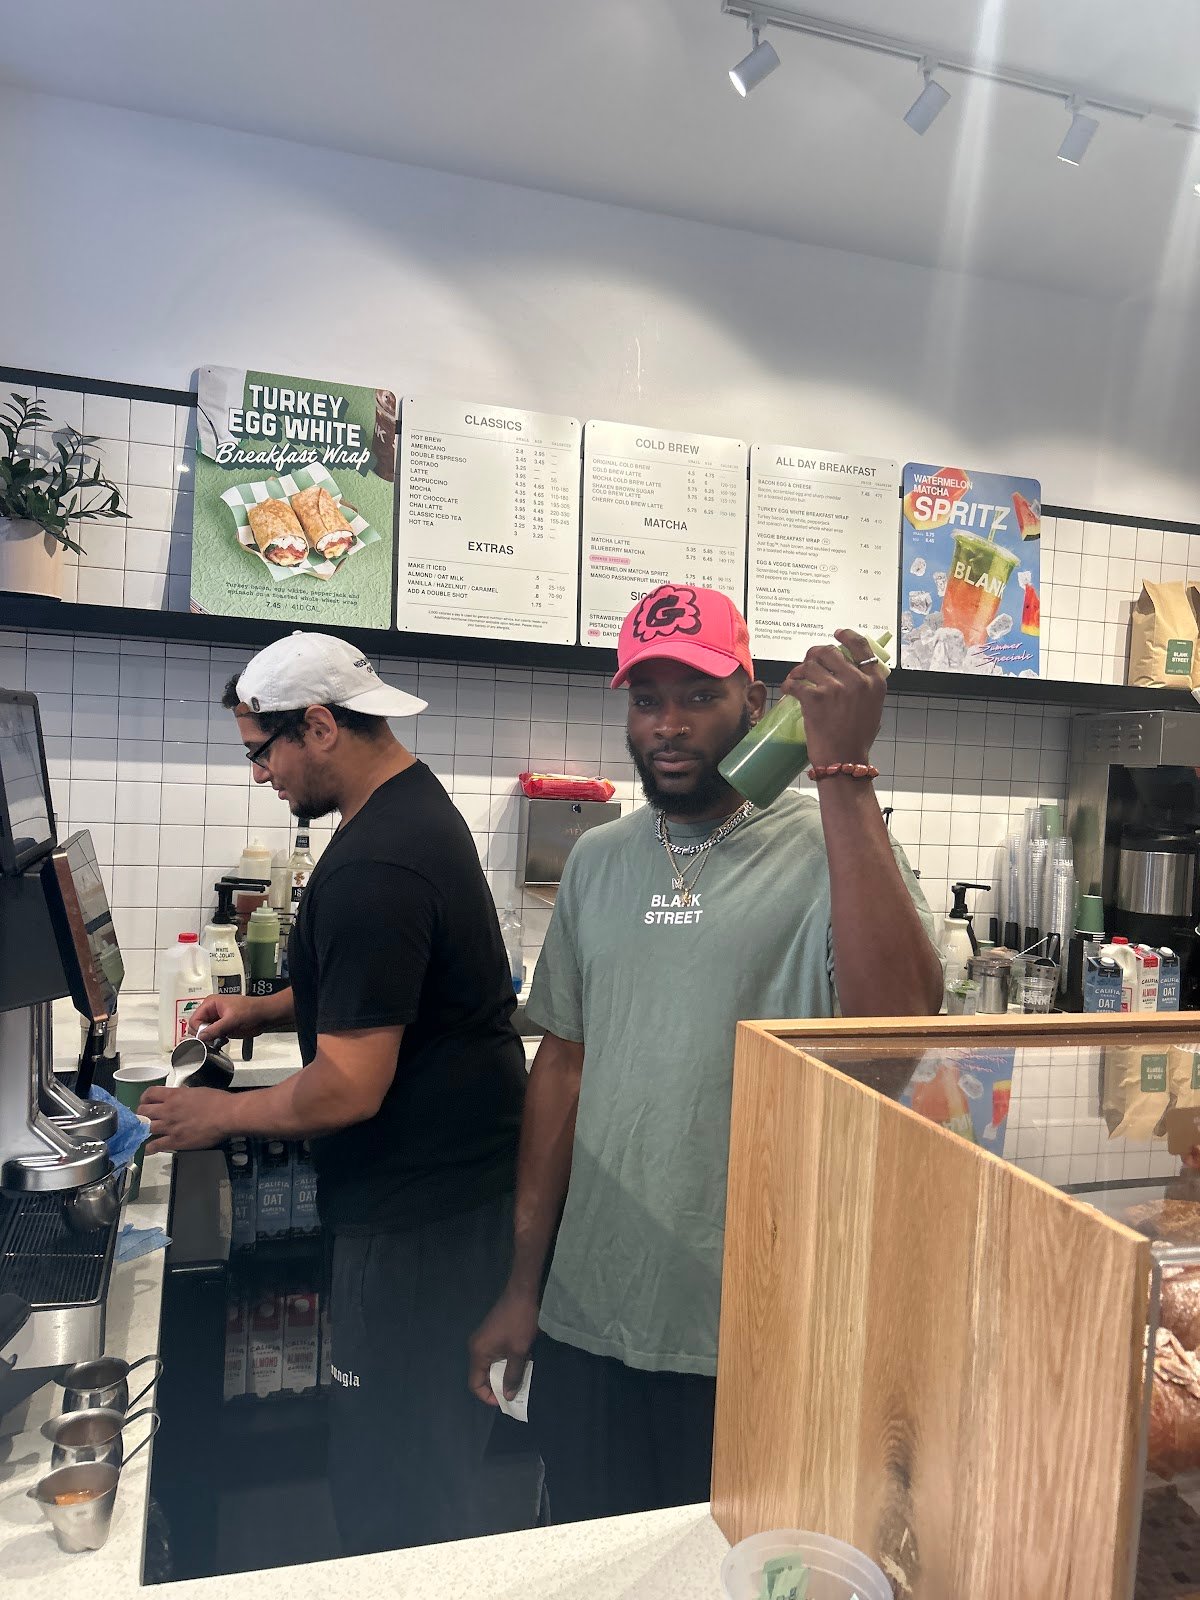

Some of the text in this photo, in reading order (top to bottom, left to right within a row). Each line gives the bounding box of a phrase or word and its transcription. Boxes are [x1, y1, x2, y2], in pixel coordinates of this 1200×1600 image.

[249, 384, 343, 418] TURKEY
[229, 408, 276, 436] EGG
[285, 416, 361, 447] WHITE
[465, 415, 522, 431] CLASSICS
[411, 443, 446, 452] AMERICANO
[636, 439, 699, 454] COLD BREW
[216, 443, 370, 470] Breakfast Wrap
[436, 454, 467, 463] ESPRESSO
[410, 460, 439, 468] CORTADO
[776, 457, 876, 476] ALL DAY BREAKFAST
[410, 477, 448, 486] CAPPUCCINO
[914, 474, 972, 490] WATERMELON
[914, 485, 949, 496] MATCHA
[423, 495, 459, 504] CHOCOLATE
[409, 511, 434, 519] CLASSIC
[806, 511, 834, 519] BREAKFAST
[914, 496, 1010, 530] SPRITZ
[644, 518, 688, 531] MATCHA
[776, 534, 805, 542] BREAKFAST
[468, 542, 514, 555] EXTRAS
[591, 545, 622, 553] BLUEBERRY
[591, 565, 626, 573] WATERMELON
[408, 571, 432, 579] ALMOND
[611, 575, 648, 583] PASSIONFRUIT
[954, 562, 1006, 598] BLANK
[437, 582, 467, 591] HAZELNUT
[589, 622, 616, 630] PISTACHIO
[651, 894, 701, 907] BLAK
[644, 910, 703, 924] STREET
[1163, 988, 1175, 996] OAT
[1099, 999, 1115, 1008] OAT
[264, 1194, 283, 1206] OAT
